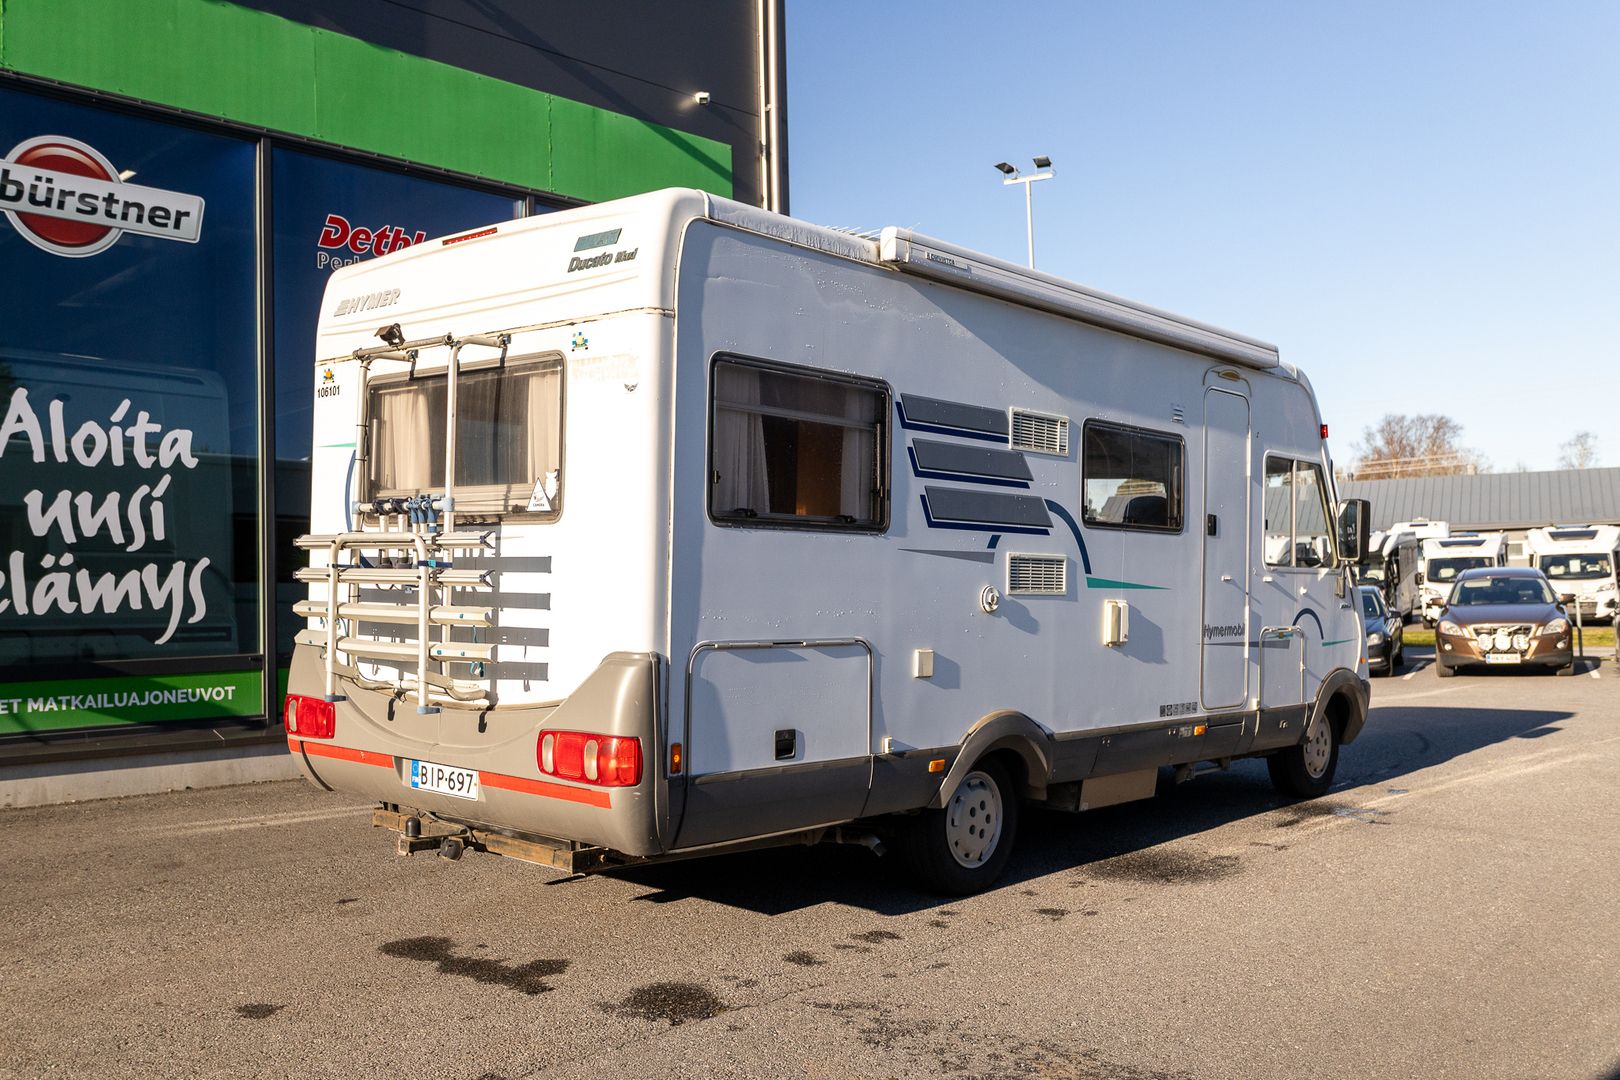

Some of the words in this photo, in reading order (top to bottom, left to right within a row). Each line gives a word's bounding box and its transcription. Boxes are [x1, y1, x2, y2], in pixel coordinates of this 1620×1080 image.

[0, 168, 191, 231] bürstner
[567, 251, 613, 273] Ducato
[346, 288, 400, 315] HYMER
[317, 385, 340, 398] 106101
[24, 474, 172, 552] uusi
[27, 686, 236, 713] MATKAILUAJONEUVOT
[420, 765, 474, 794] BIP-697
